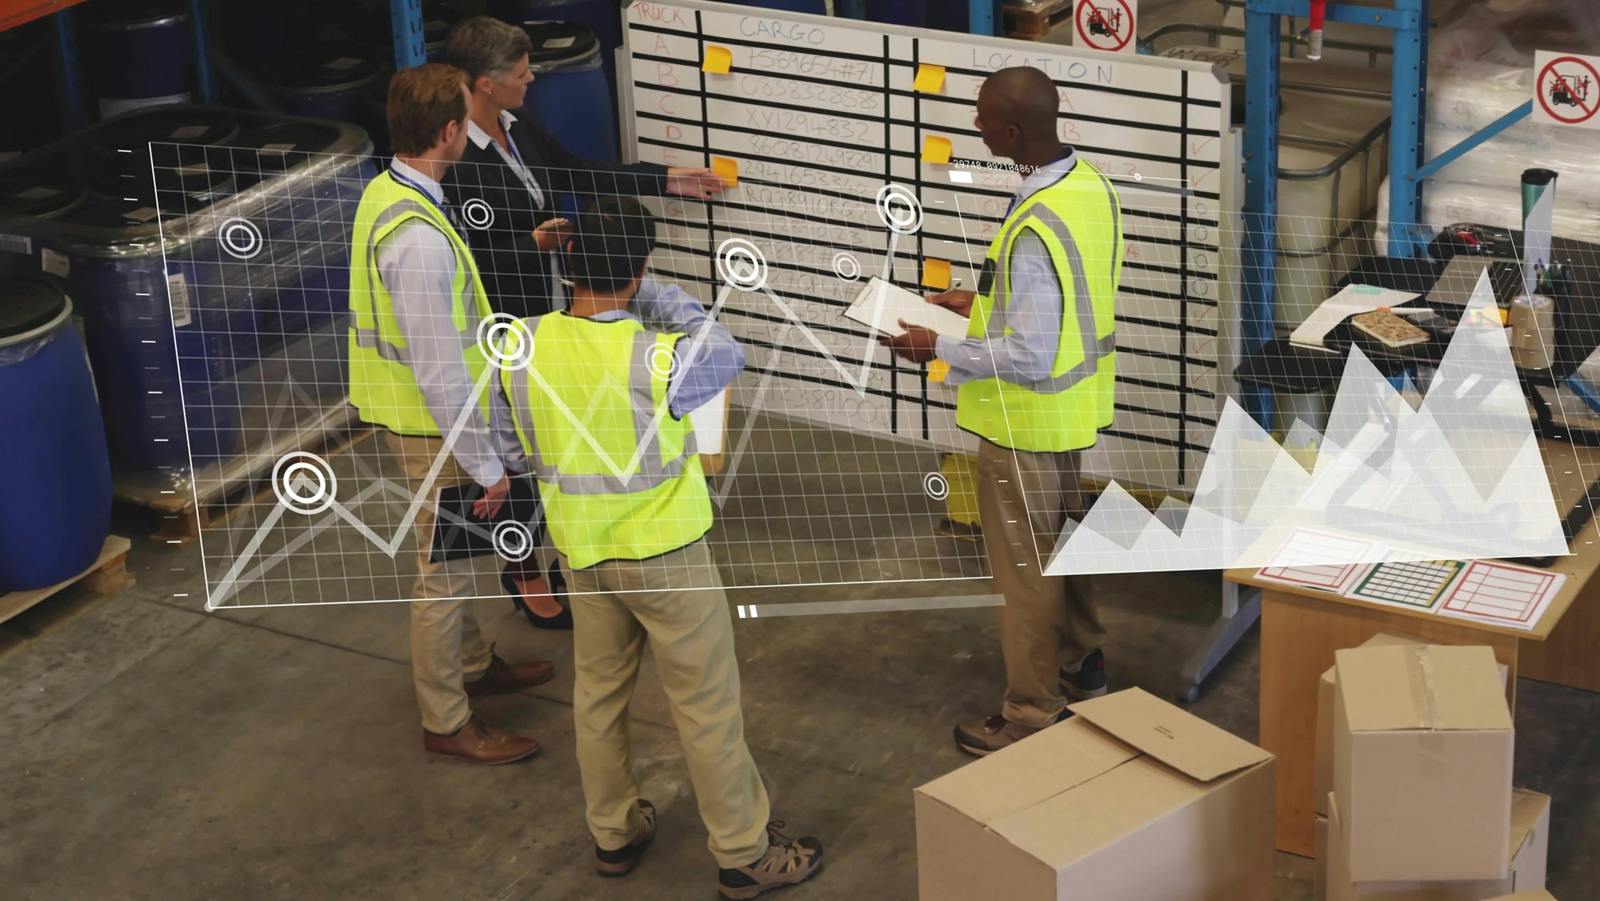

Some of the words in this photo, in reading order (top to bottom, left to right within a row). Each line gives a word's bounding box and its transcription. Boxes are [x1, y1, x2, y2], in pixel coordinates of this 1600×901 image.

[633, 2, 688, 26] TRUCK
[740, 17, 825, 45] CARGO
[657, 62, 680, 87] B
[1063, 121, 1082, 142] B
[658, 93, 674, 115] C
[666, 124, 682, 141] D
